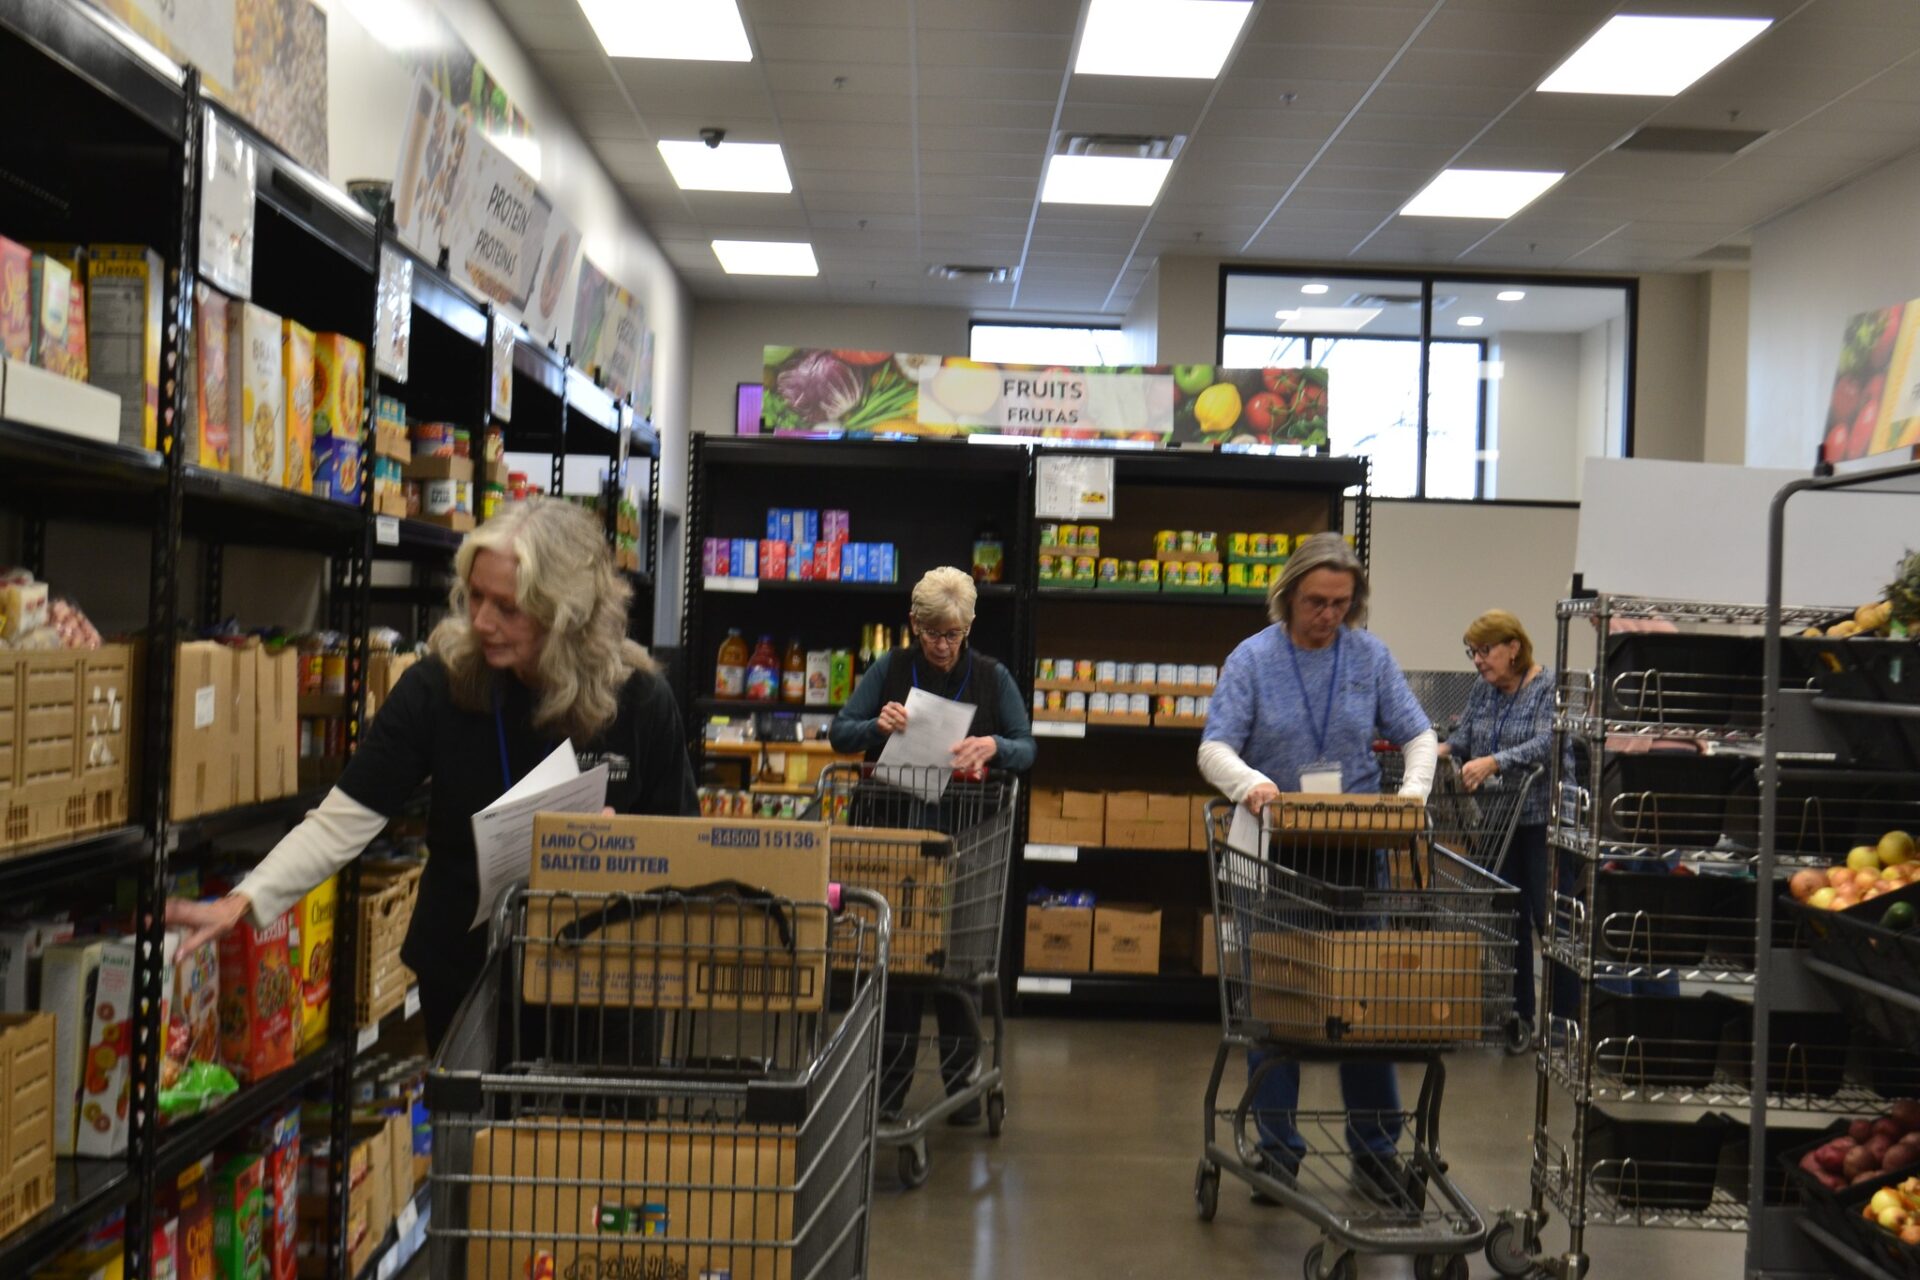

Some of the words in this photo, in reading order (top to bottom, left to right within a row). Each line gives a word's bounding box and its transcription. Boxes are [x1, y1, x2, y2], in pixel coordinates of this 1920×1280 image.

[486, 181, 532, 237] PROTEIN
[474, 228, 518, 278] PROTEINAS
[1003, 379, 1082, 399] FRUITS
[1007, 407, 1079, 423] FRUTAS
[541, 833, 576, 849] LAND
[599, 835, 635, 851] LAKES
[712, 828, 759, 848] 34500
[764, 830, 814, 849] 15136
[541, 853, 600, 872] SALTED
[606, 856, 669, 874] BUTTER
